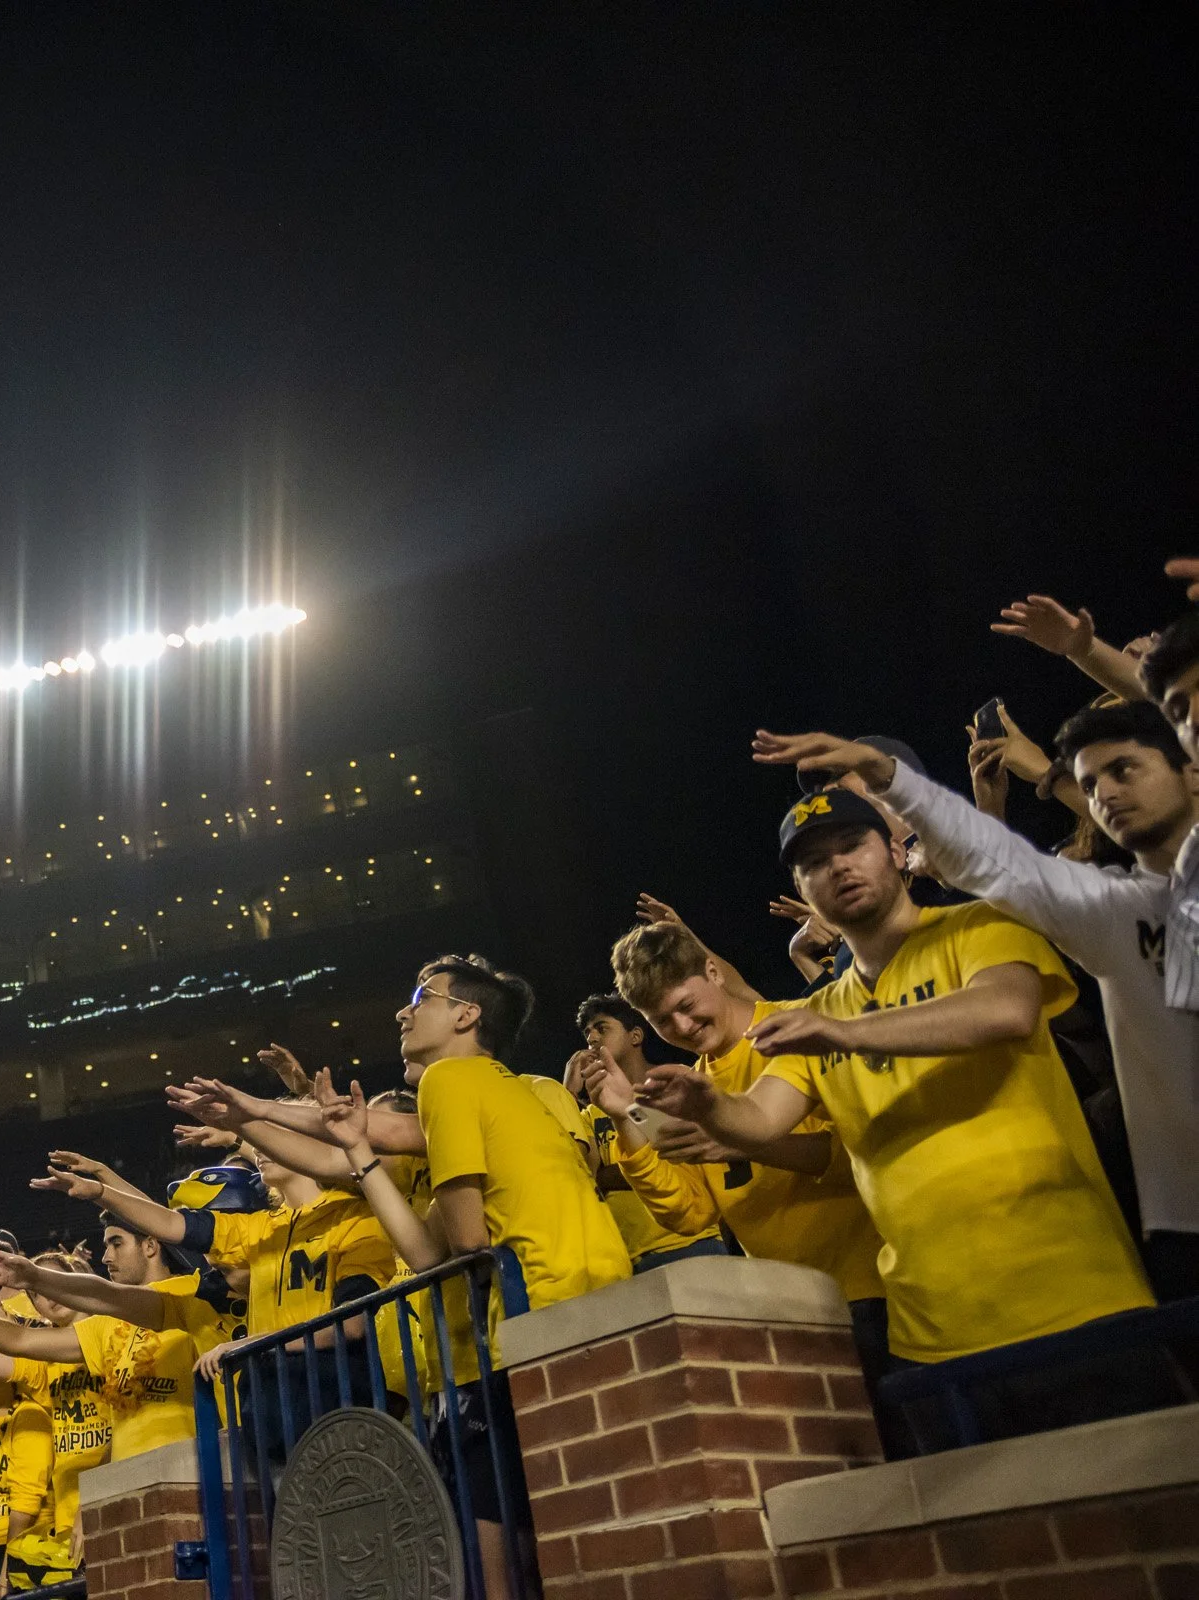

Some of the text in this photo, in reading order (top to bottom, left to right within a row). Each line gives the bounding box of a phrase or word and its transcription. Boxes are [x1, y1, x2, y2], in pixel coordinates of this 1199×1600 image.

[791, 795, 832, 827] M
[1137, 920, 1166, 959] M
[287, 1249, 328, 1292] M
